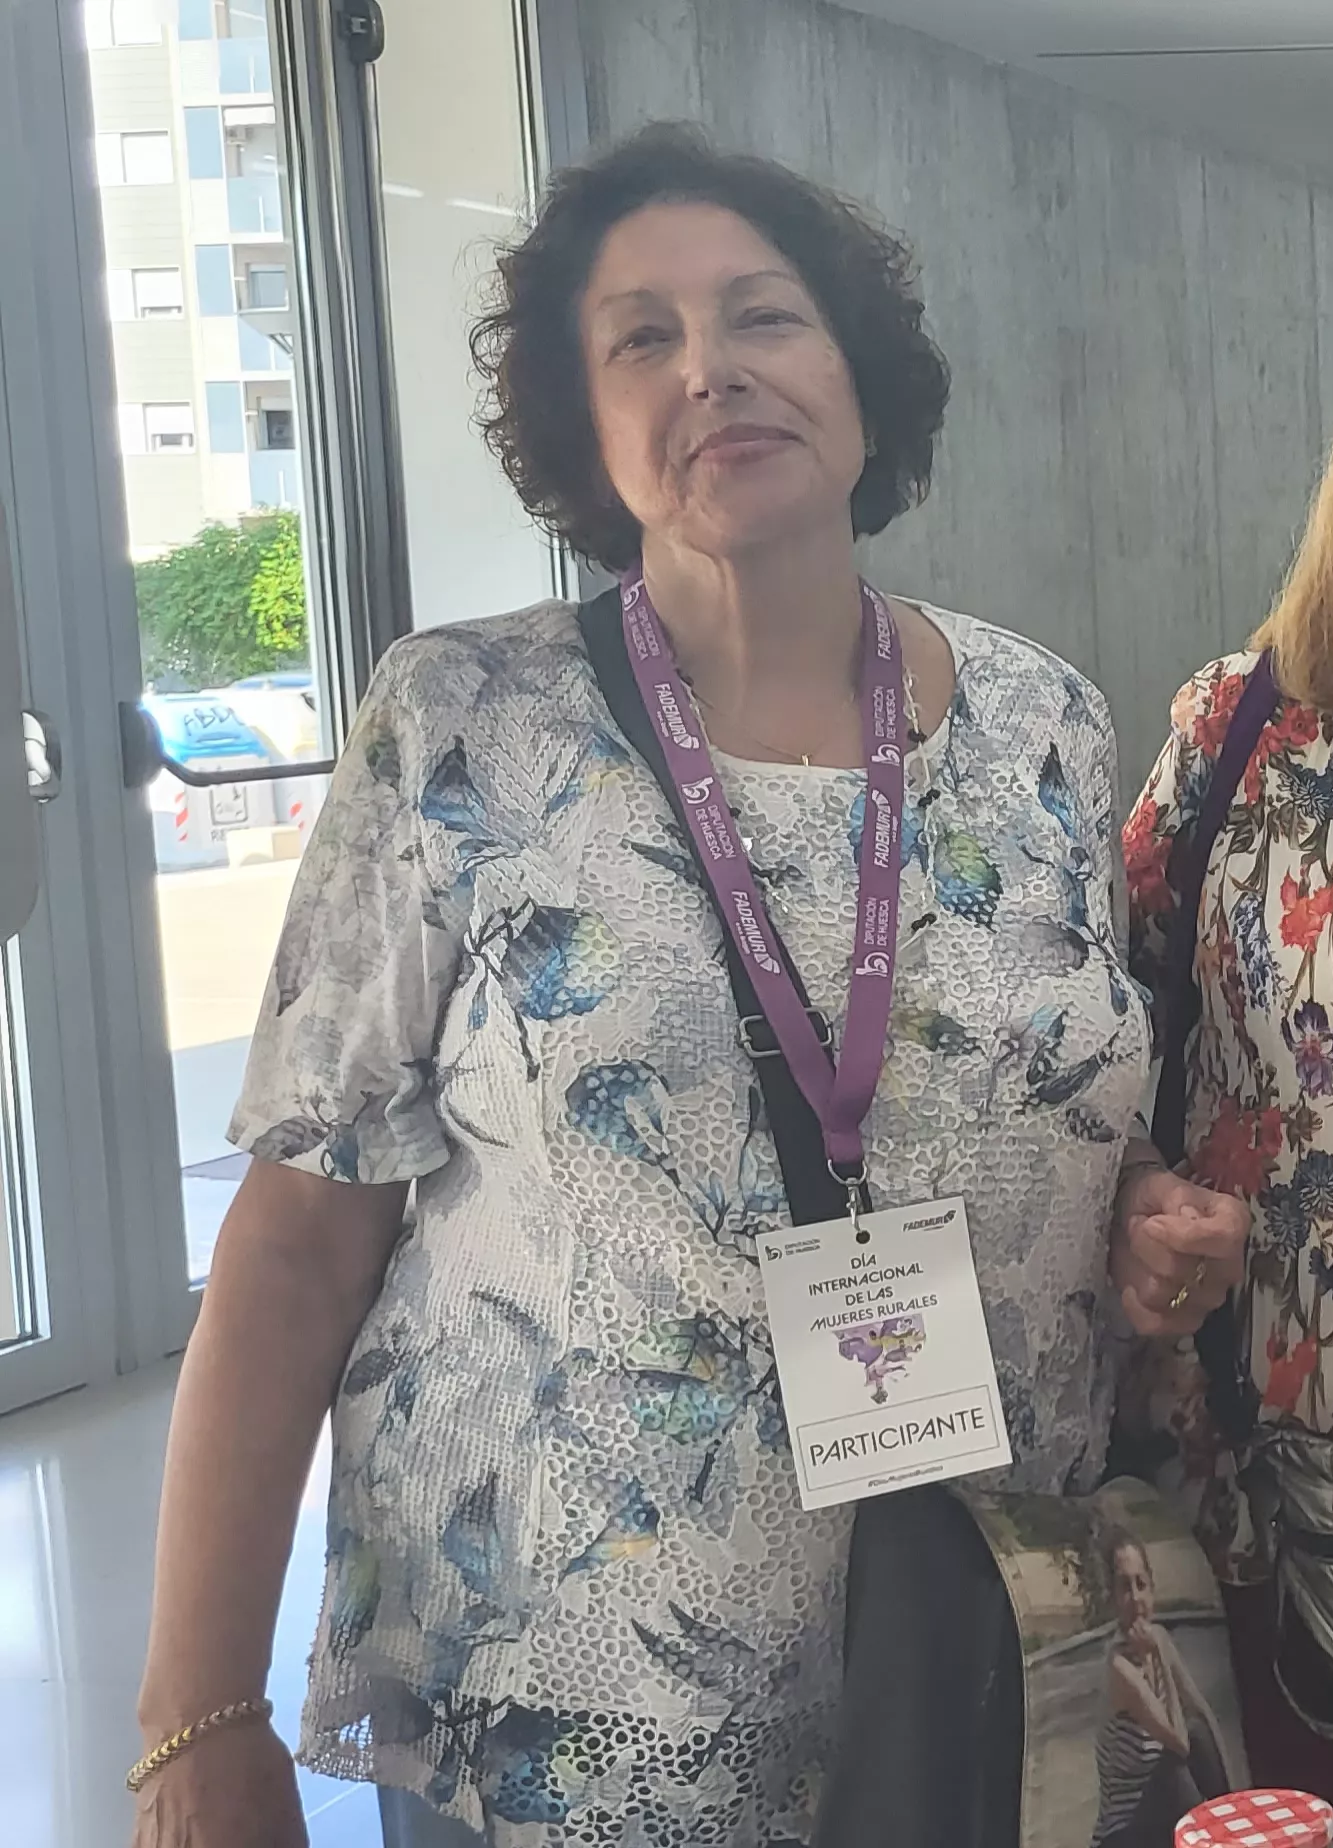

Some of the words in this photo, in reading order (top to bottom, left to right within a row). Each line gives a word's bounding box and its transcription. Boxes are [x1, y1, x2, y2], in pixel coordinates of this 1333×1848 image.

[654, 683, 687, 737] FADEMUR
[886, 688, 896, 727] HUESCA
[886, 728, 896, 740] DE
[695, 808, 703, 822] DE
[700, 822, 722, 860] HUESCA
[873, 812, 892, 869] FADEMUR
[732, 890, 766, 954] FADEMUR
[877, 899, 890, 933] HUESCA
[877, 933, 888, 947] DE
[902, 1215, 945, 1232] FADEMUR
[808, 1262, 924, 1297] INTERNACIONAL
[850, 1253, 877, 1270] DÍA
[810, 1308, 874, 1332] MUJERES
[877, 1294, 938, 1315] RURALES
[845, 1292, 865, 1306] DE
[867, 1286, 894, 1302] LAS
[809, 1407, 985, 1467] PARTICIPANTE
